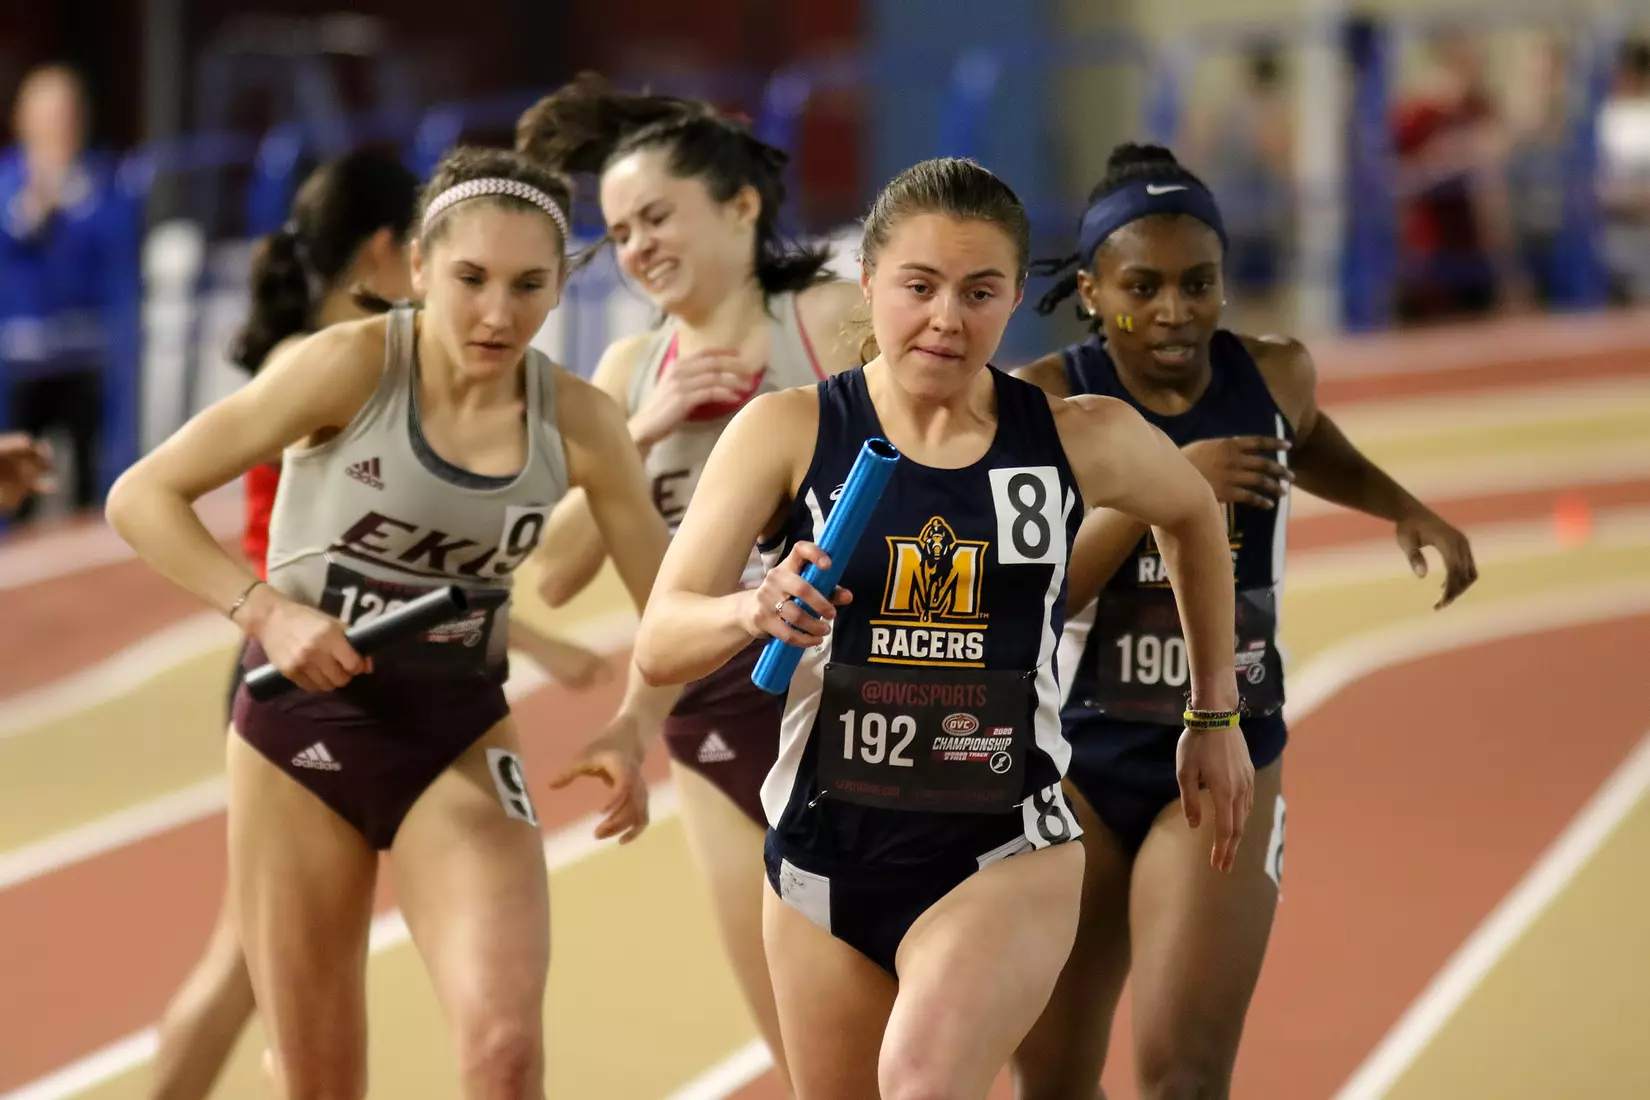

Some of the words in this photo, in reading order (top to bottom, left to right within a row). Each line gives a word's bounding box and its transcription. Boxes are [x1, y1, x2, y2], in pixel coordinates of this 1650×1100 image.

[1008, 472, 1051, 560] 8
[494, 512, 544, 575] 9
[871, 628, 985, 660] RACERS
[1116, 634, 1188, 687] 190
[862, 680, 989, 708] @OVCSPORTS
[839, 709, 917, 767] 192
[949, 720, 971, 730] OVC
[993, 727, 1014, 736] 2020
[932, 737, 1013, 752] CHAMPIONSHIP
[291, 758, 342, 772] adidas
[1033, 784, 1072, 845] 8
